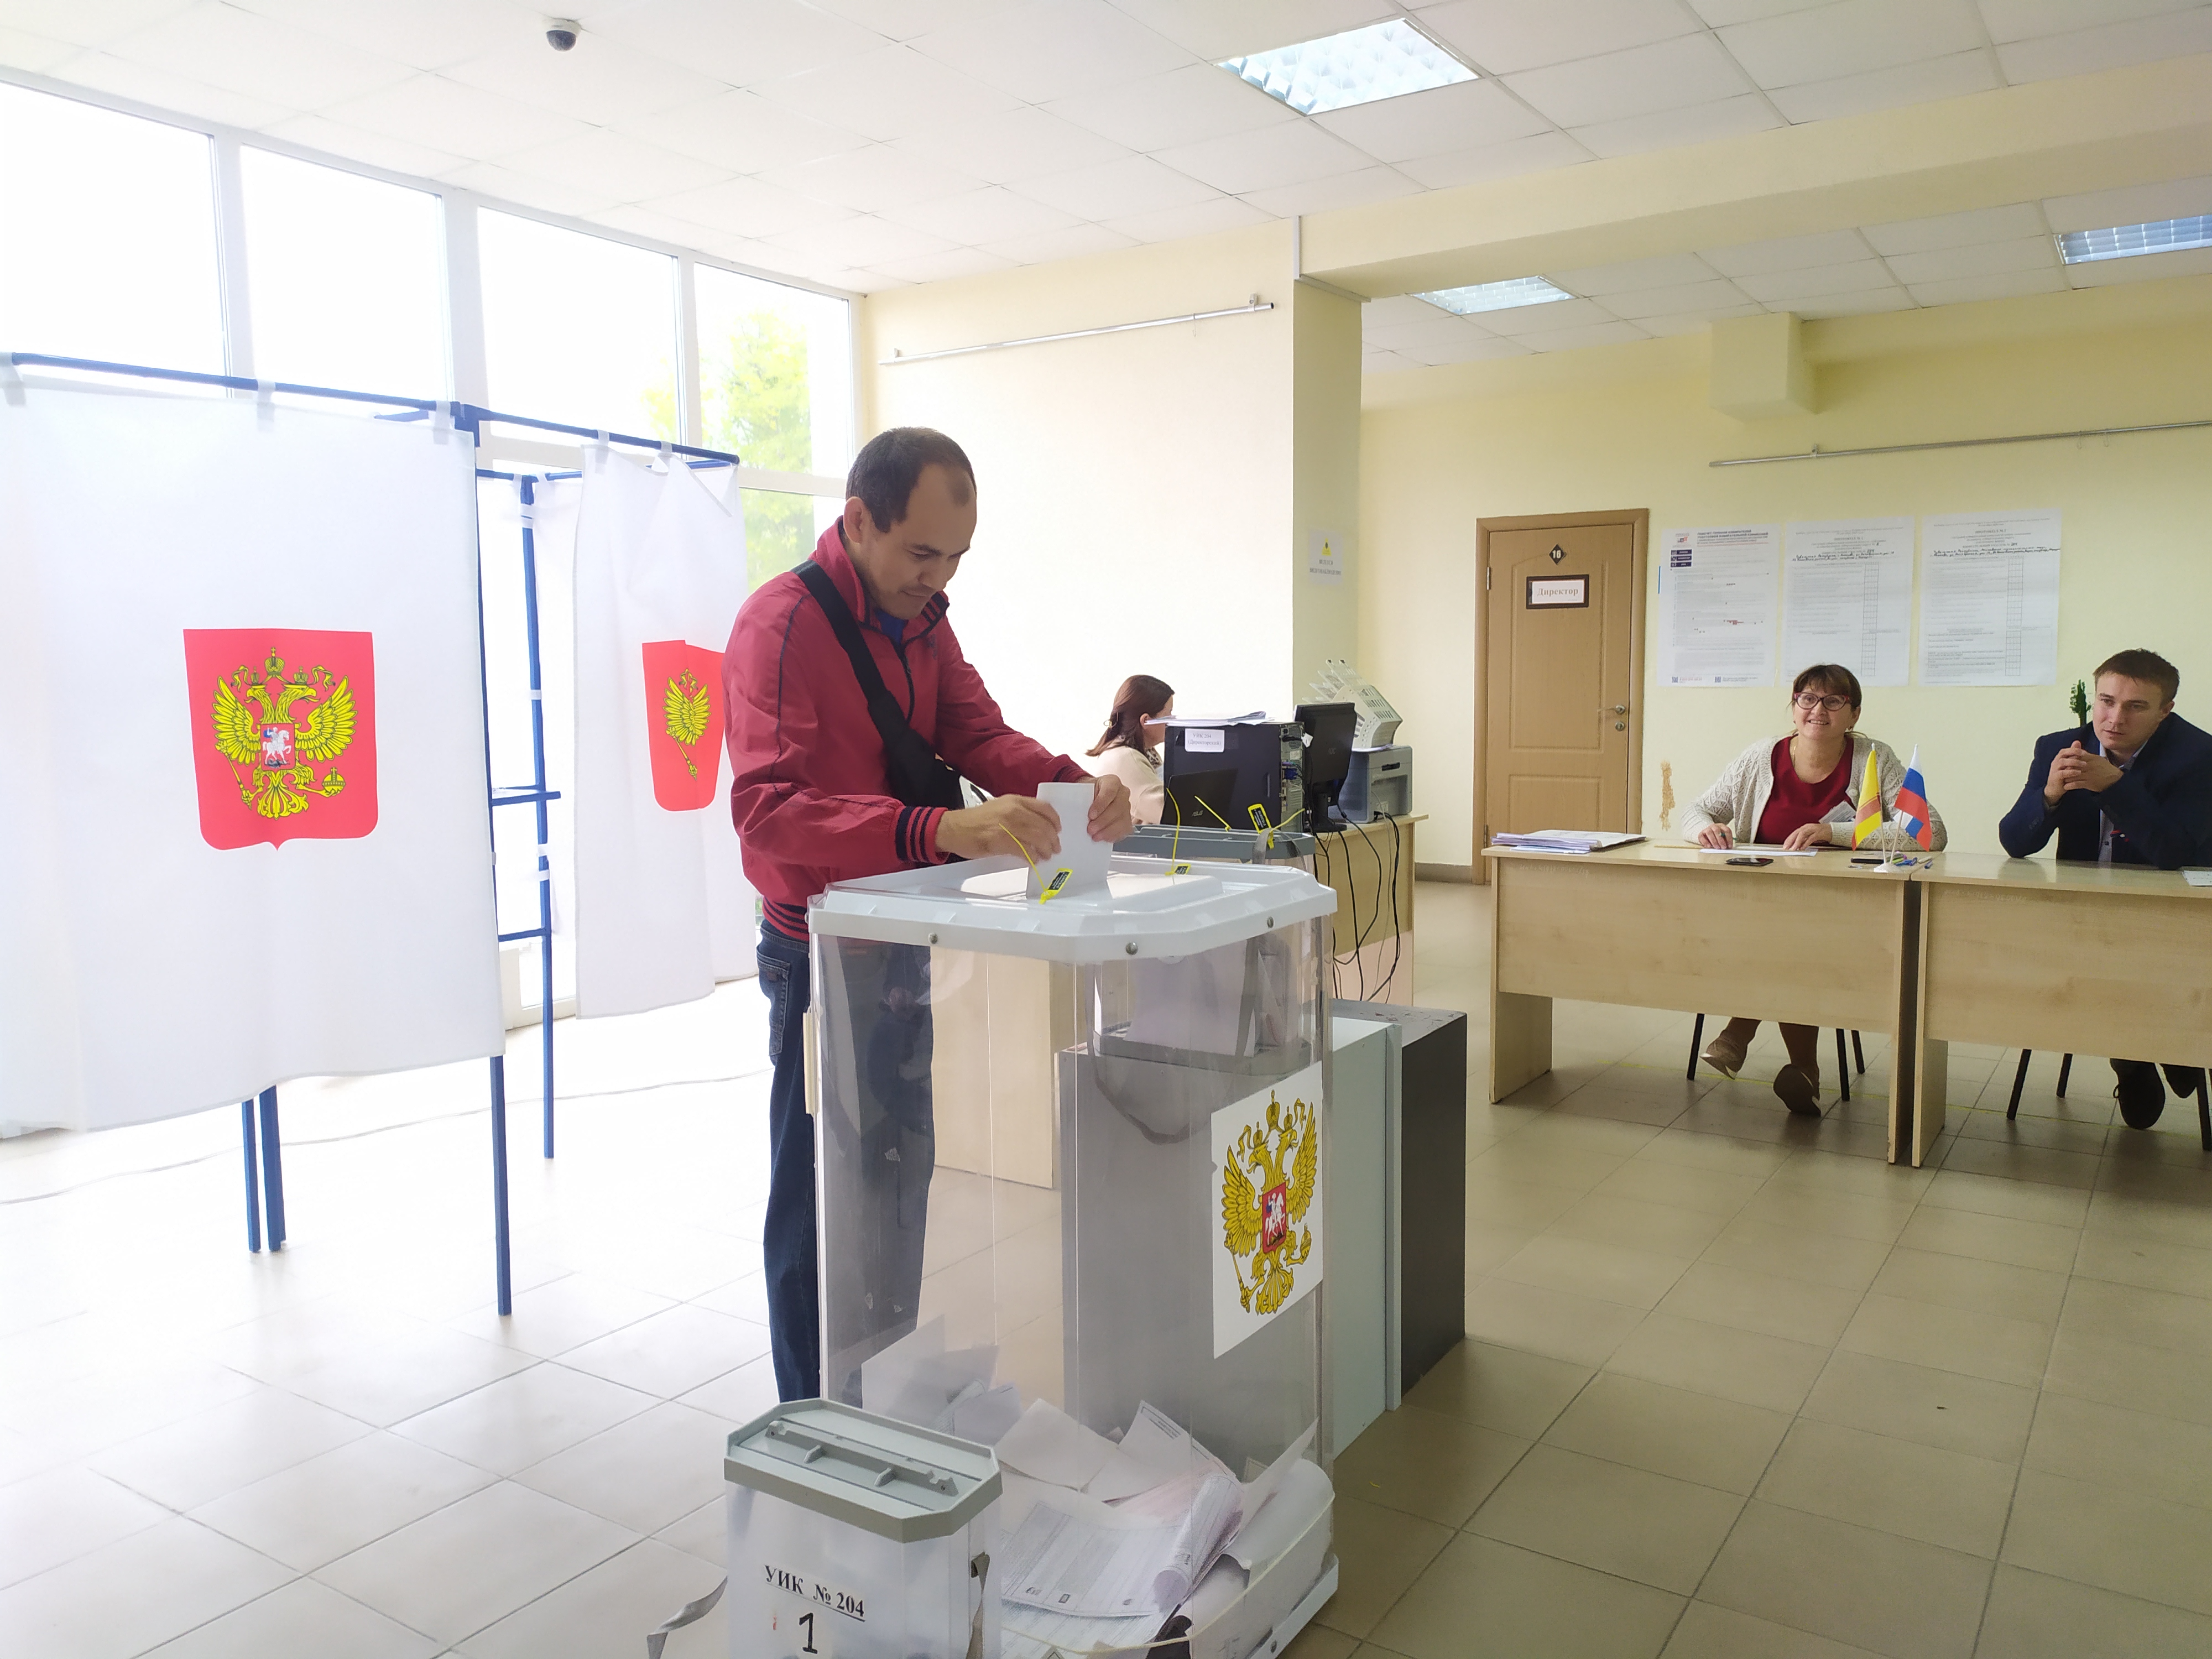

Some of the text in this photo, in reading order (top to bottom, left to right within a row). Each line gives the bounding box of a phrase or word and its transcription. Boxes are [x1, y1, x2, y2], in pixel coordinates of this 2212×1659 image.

[1537, 588, 1578, 597] Директор
[764, 1564, 864, 1617] УИК № 204
[799, 1612, 818, 1655] 1
